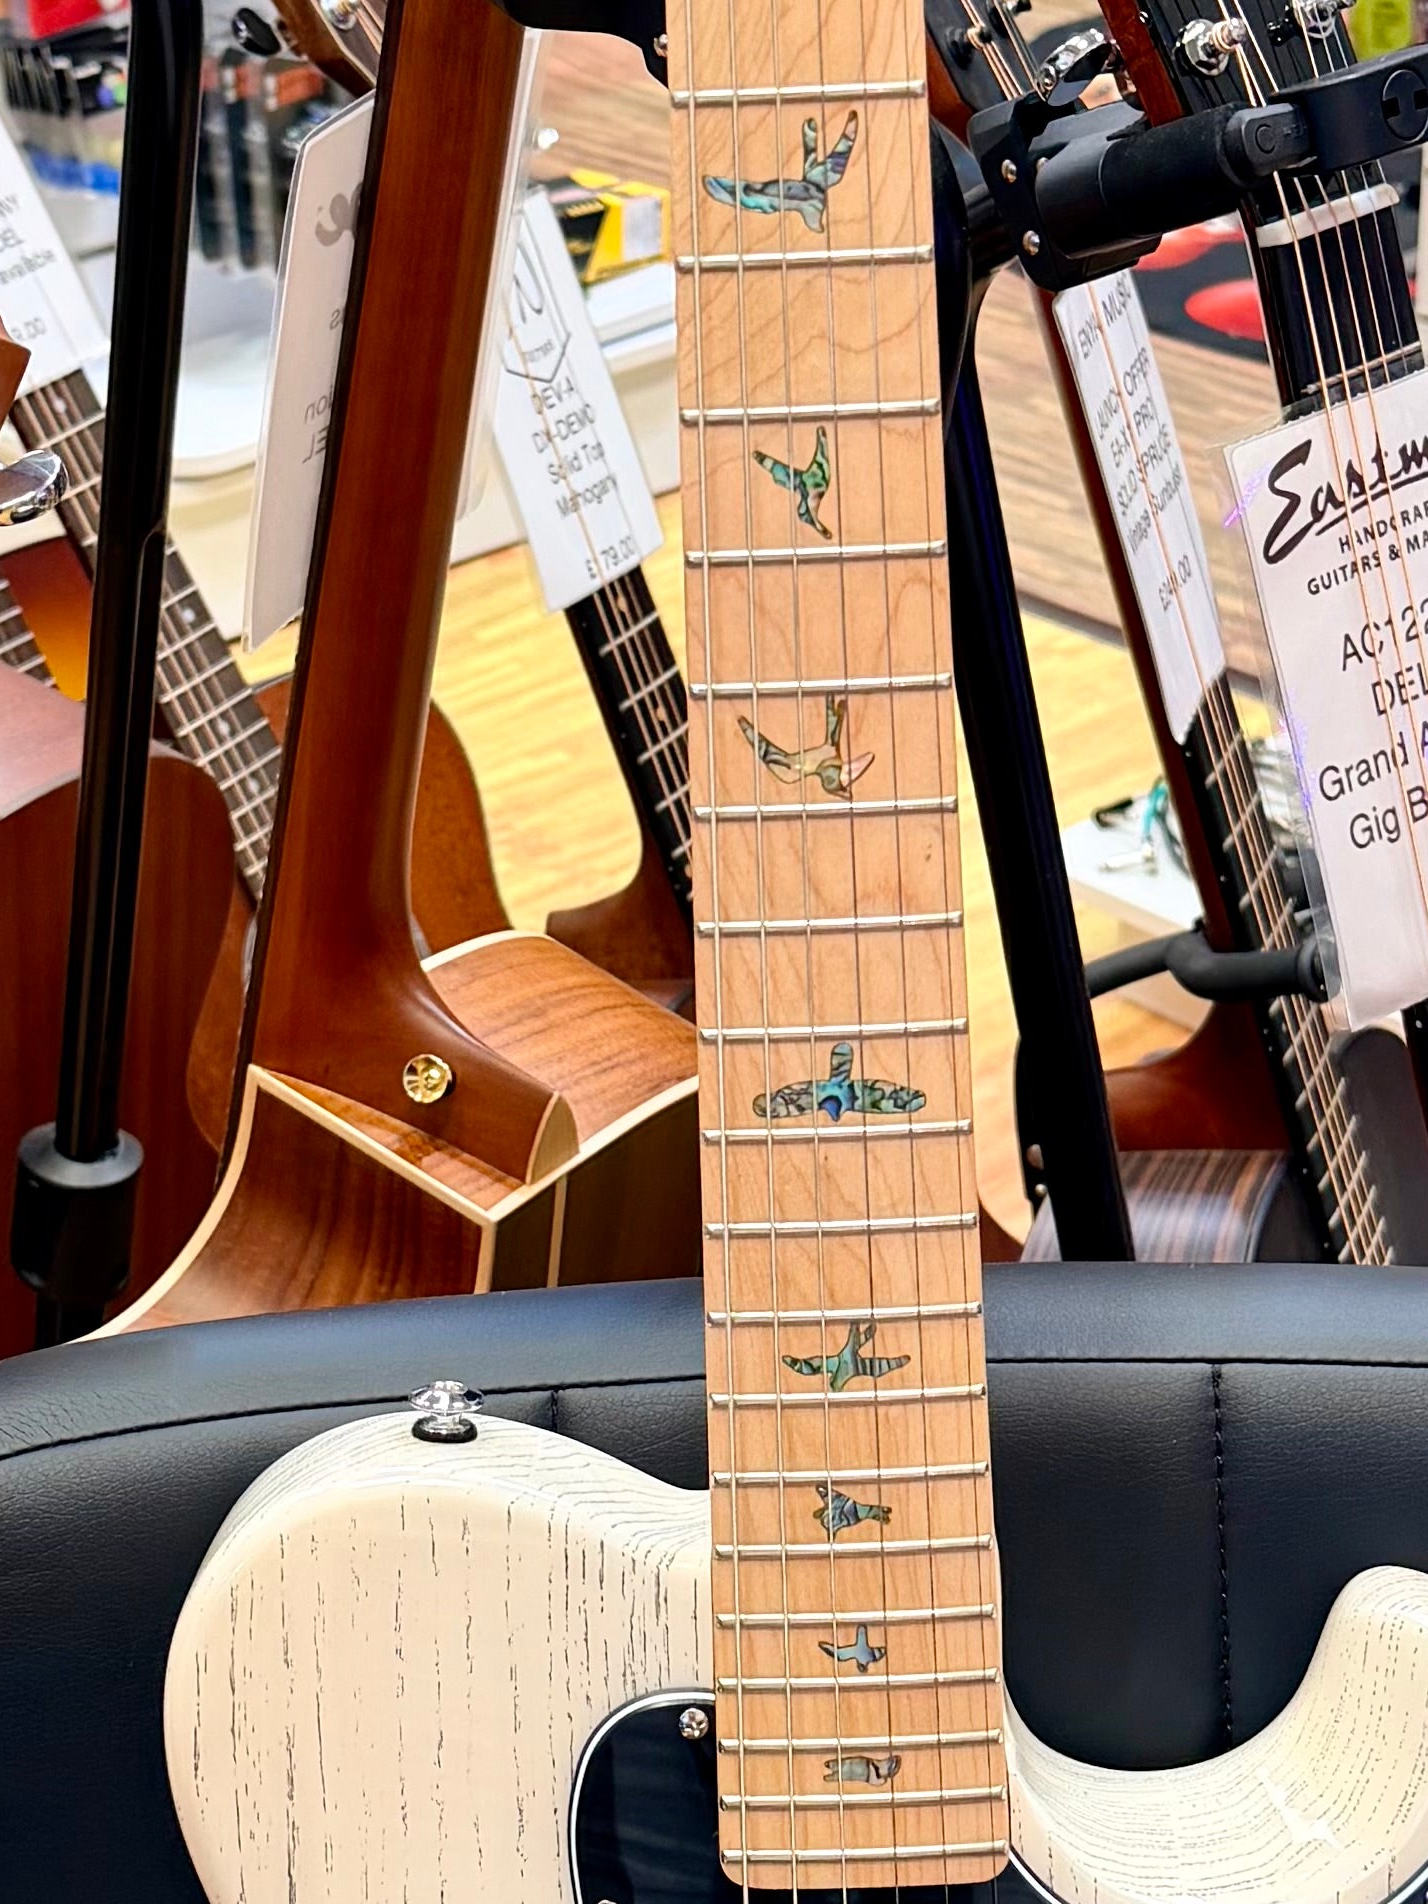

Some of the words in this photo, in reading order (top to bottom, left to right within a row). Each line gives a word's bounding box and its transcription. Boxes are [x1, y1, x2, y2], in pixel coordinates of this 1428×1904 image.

[548, 453, 581, 486] Soid
[1307, 550, 1381, 596] GUITARS
[1389, 542, 1407, 562] &
[1319, 730, 1409, 802] Grand
[1350, 804, 1401, 850] Gig
